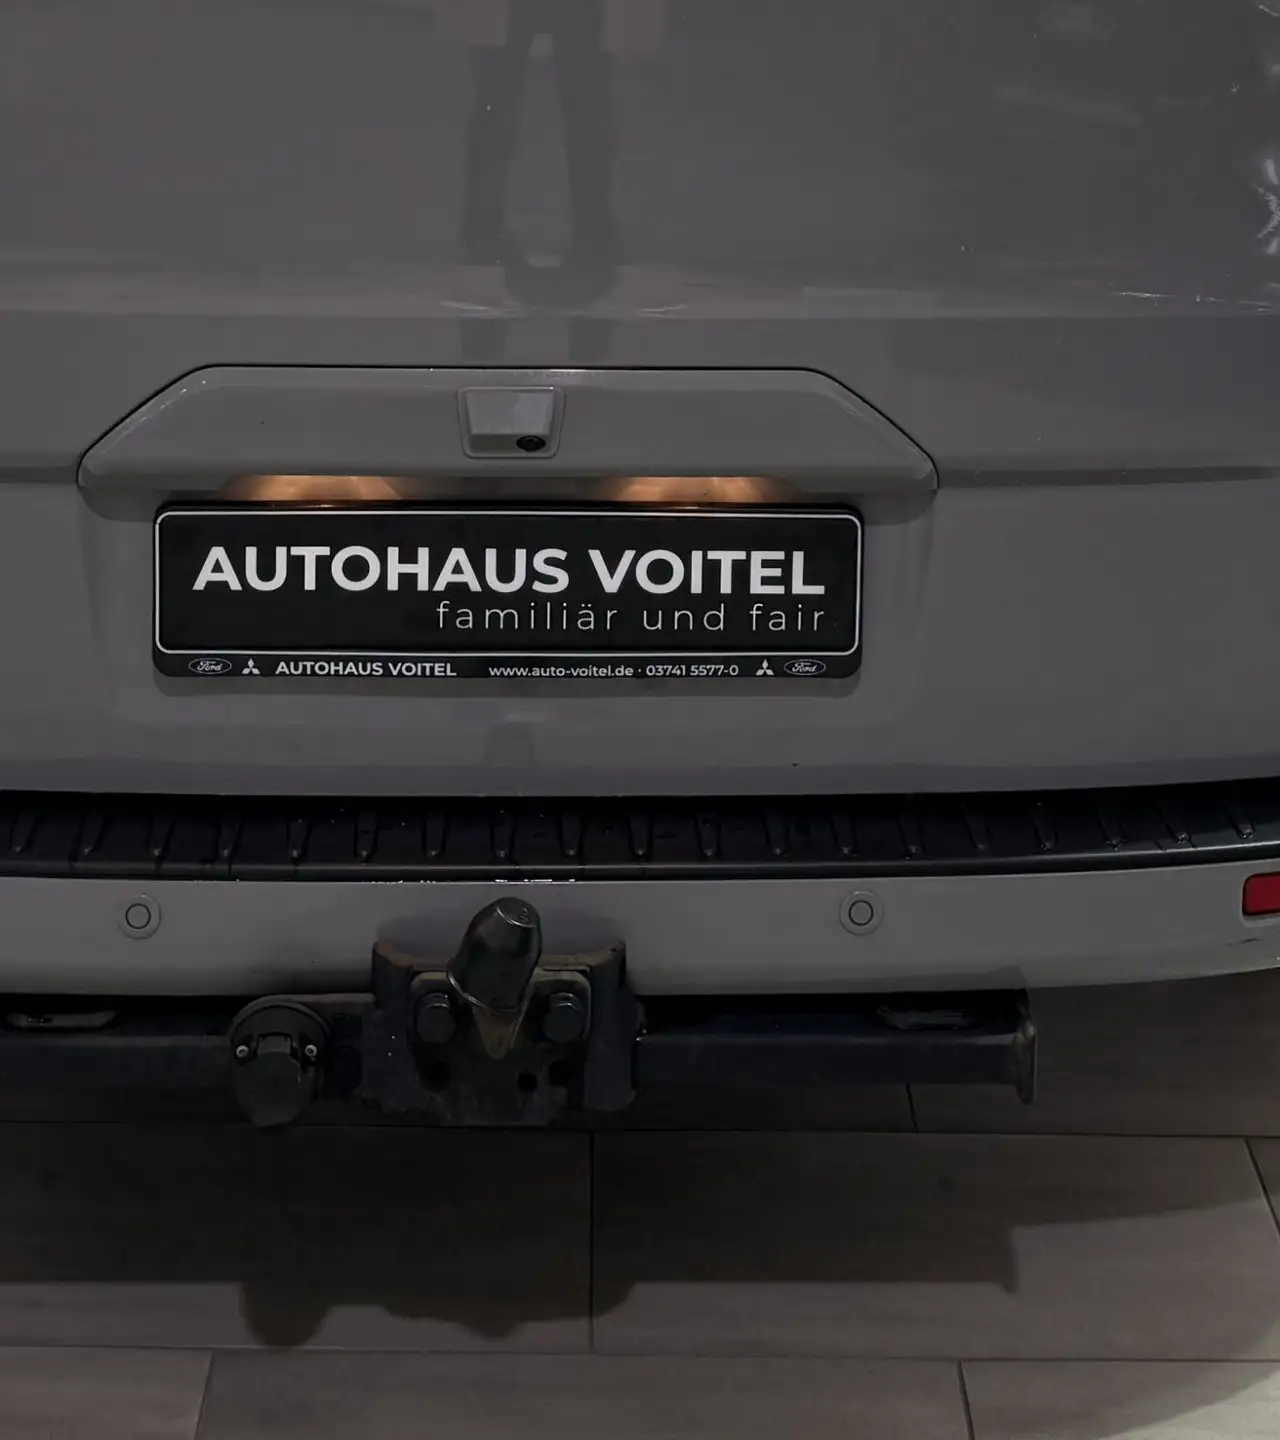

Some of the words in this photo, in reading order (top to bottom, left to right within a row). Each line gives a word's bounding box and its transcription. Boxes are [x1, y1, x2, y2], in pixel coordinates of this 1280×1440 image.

[193, 545, 570, 594] AUTOHAUS
[588, 548, 825, 596] VOITEL
[436, 600, 619, 631] familiär
[643, 601, 725, 632] und
[749, 603, 826, 632] fair
[196, 660, 223, 674] Ford
[276, 661, 384, 676] AUTOHAUS
[387, 662, 457, 676] VOITEL
[489, 663, 634, 678] www.auto-voitel.de
[645, 664, 687, 677] 03741
[690, 664, 739, 677] 5577-0
[793, 661, 820, 675] Ford
